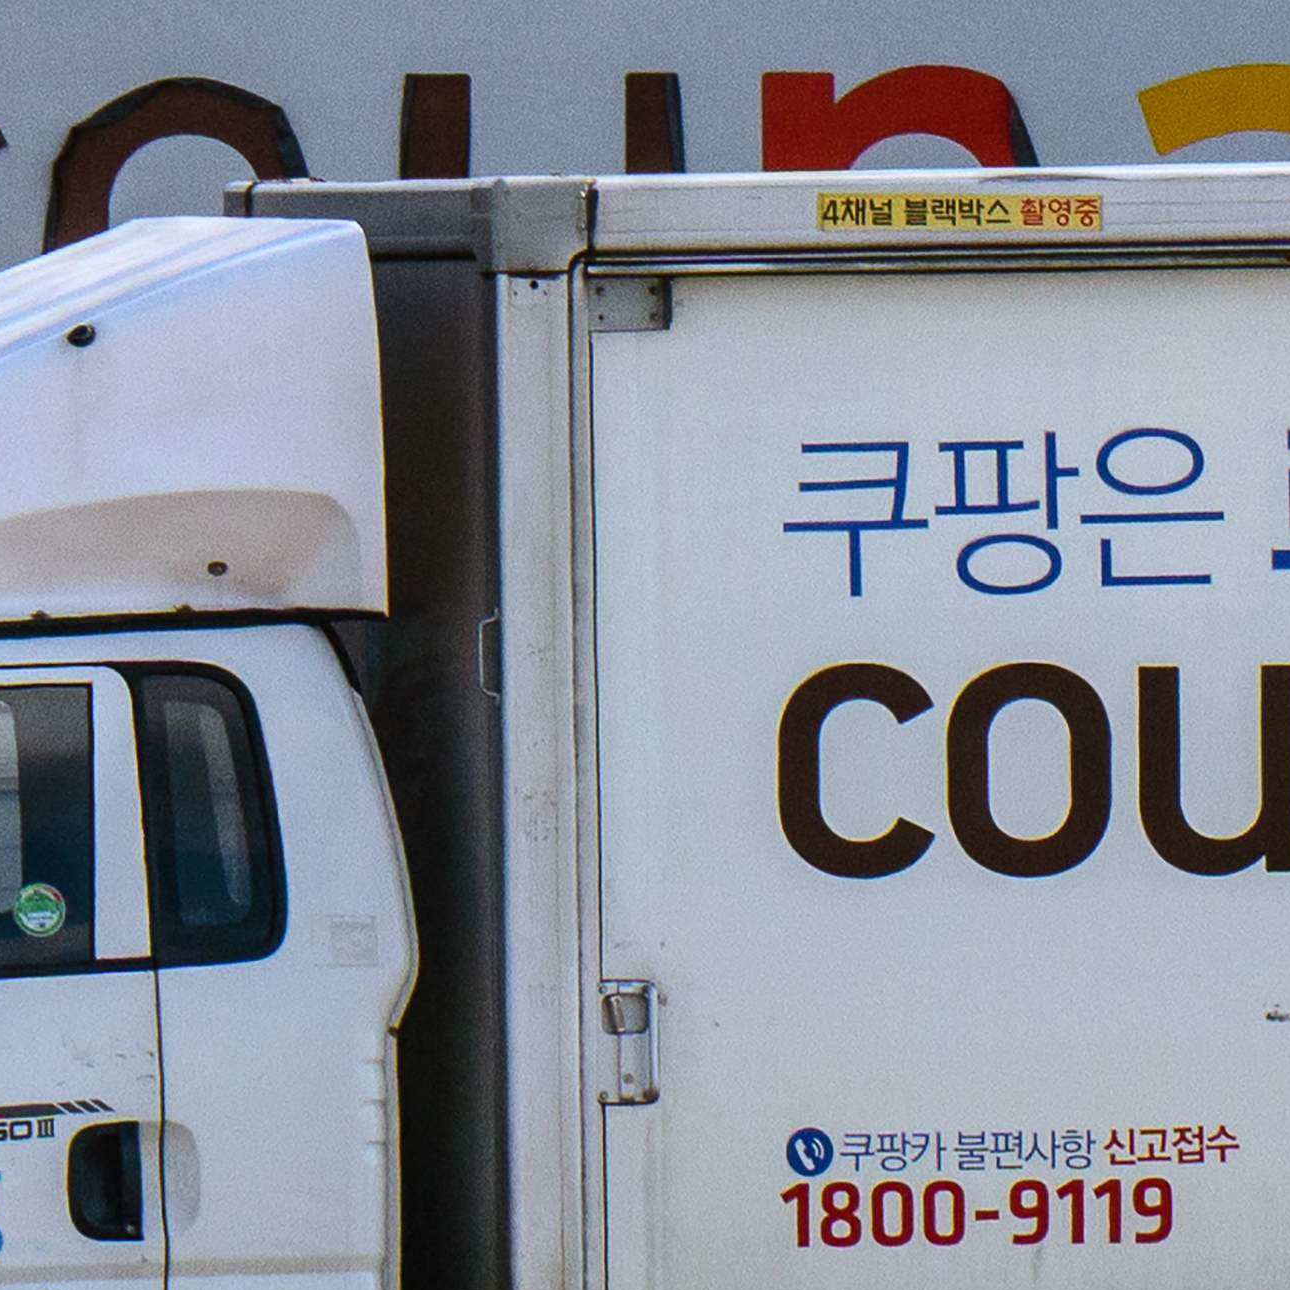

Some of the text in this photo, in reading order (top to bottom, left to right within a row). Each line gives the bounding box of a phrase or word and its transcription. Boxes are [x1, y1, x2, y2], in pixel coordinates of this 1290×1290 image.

[820, 197, 1100, 228] 4채널 블랙박스 촬영중
[782, 426, 1226, 599] 쿠팡은
[839, 1125, 1241, 1173] 쿠팡카 불편사항 신고접수
[780, 1177, 1174, 1248] 1800-9119
